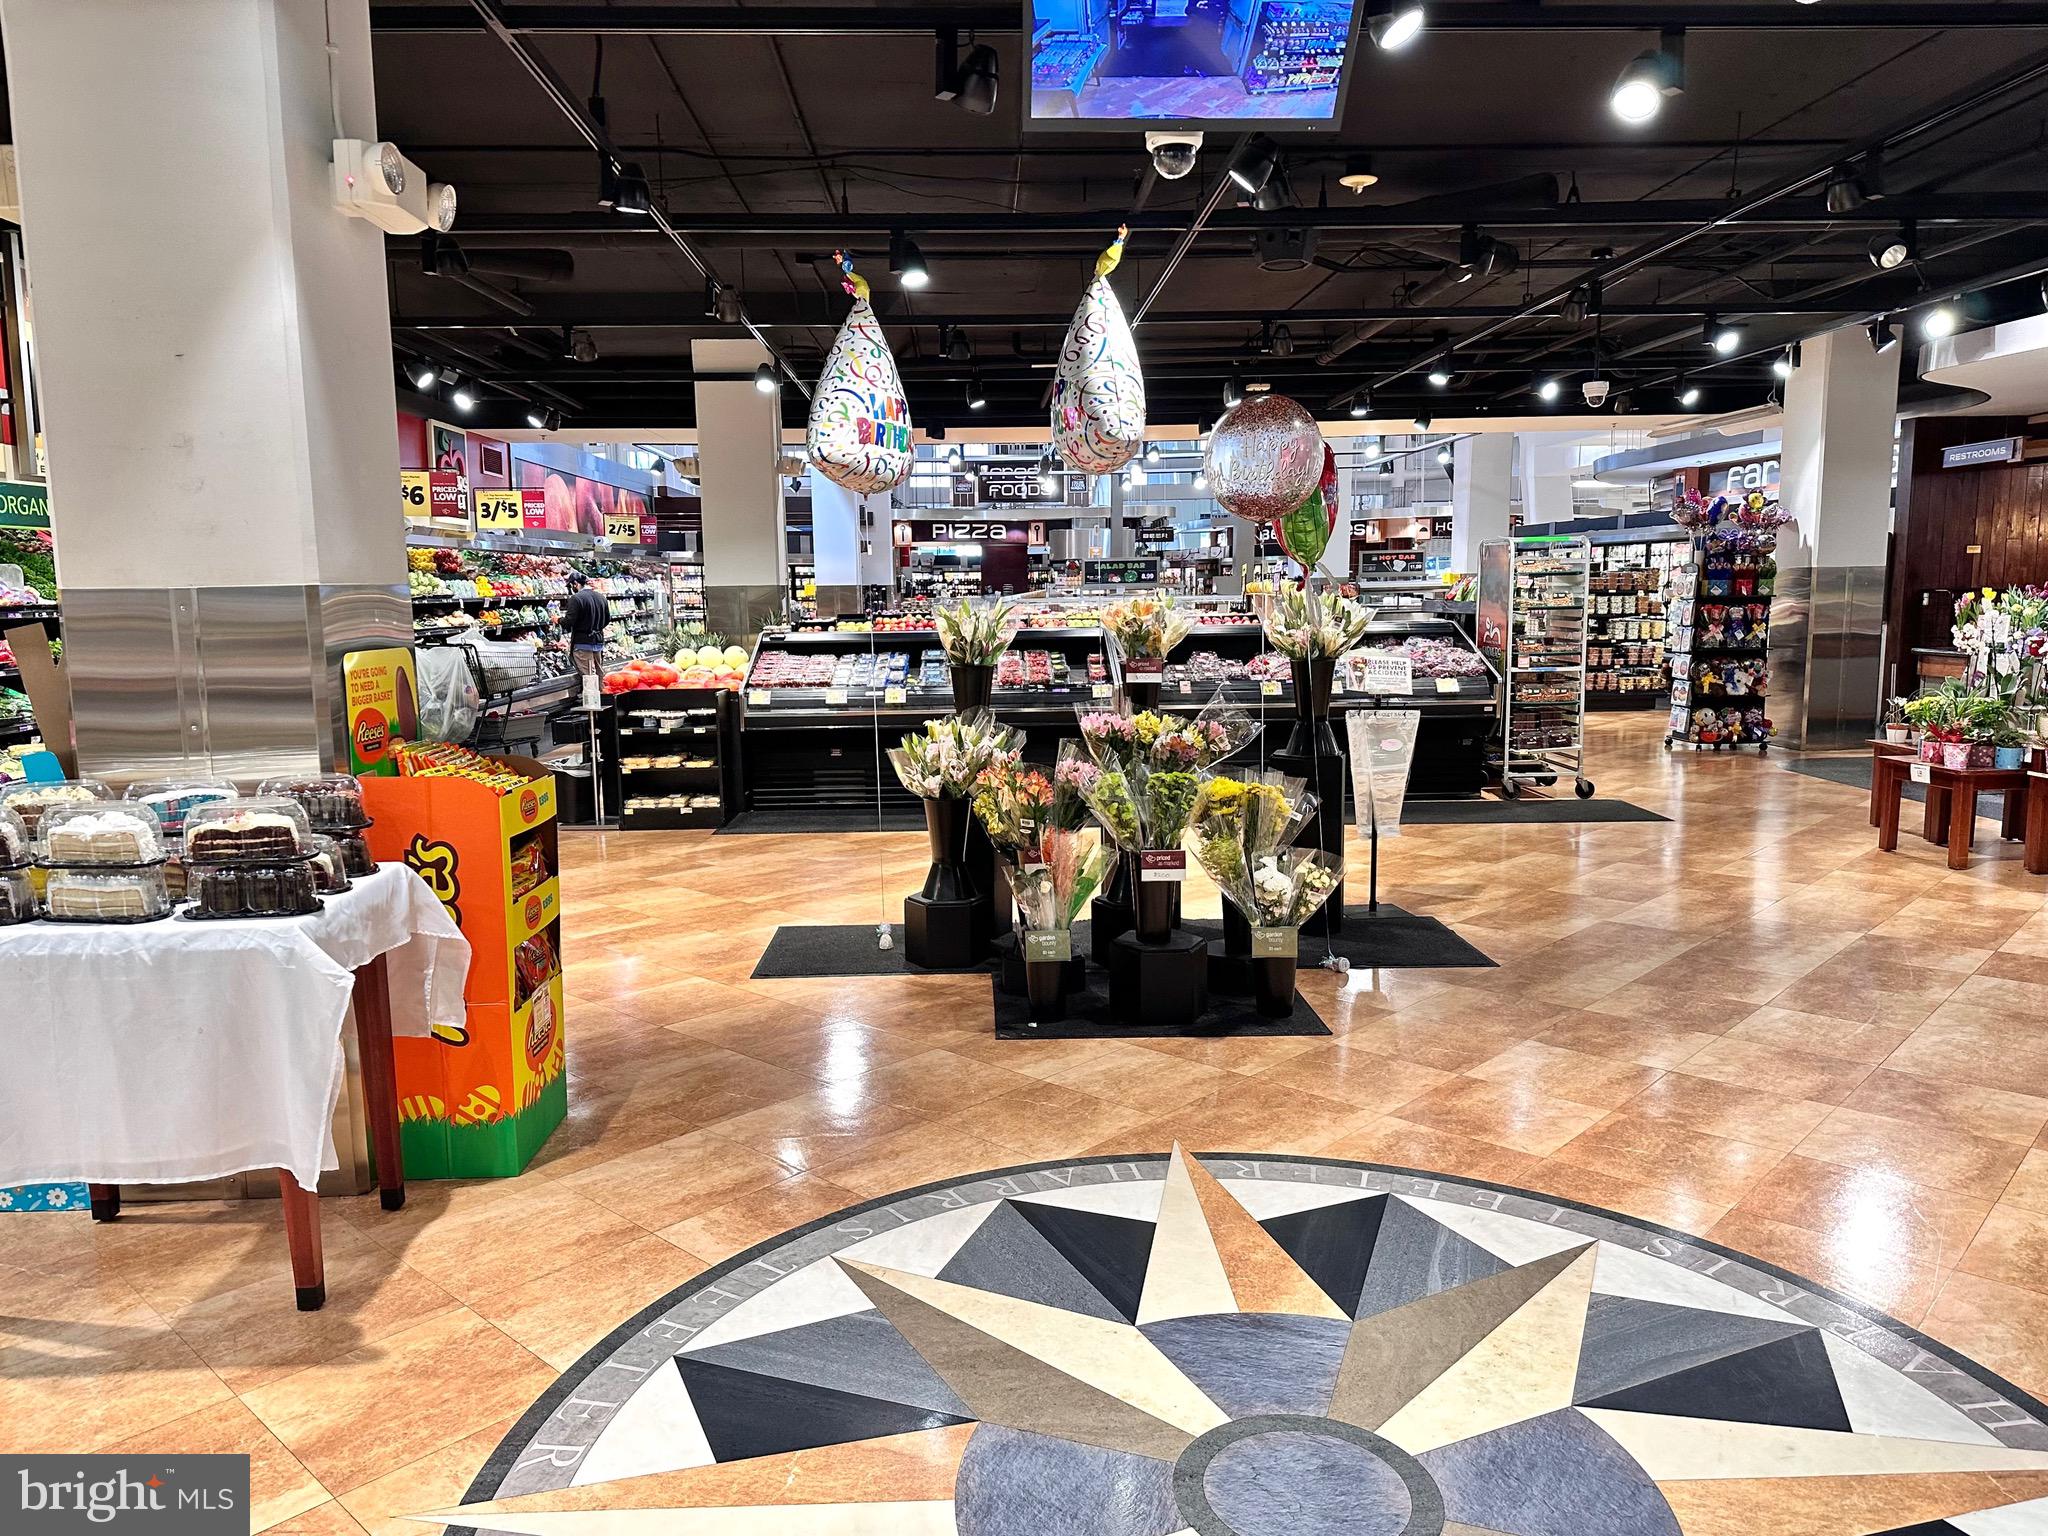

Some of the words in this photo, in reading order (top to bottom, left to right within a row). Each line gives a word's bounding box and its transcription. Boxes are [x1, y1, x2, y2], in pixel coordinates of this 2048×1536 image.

[1949, 446, 2006, 462] RESTROOMS
[401, 484, 425, 505] $6
[434, 493, 457, 501] LOW
[480, 500, 518, 521] 3/$5
[525, 508, 544, 516] LOW
[608, 523, 636, 536] 2/$5
[1094, 562, 1126, 570] SALAD
[1127, 562, 1146, 570] BAR
[350, 667, 370, 680] YOU'RE
[370, 665, 388, 678] GOING
[351, 682, 359, 694] TO
[360, 680, 375, 692] NEED
[375, 680, 380, 689] A
[351, 694, 374, 707] BIGGER
[374, 689, 393, 703] BASKET
[357, 720, 385, 743] Reese's
[836, 1163, 1144, 1241] HARRIS
[1236, 1162, 1569, 1225] TEETER
[1641, 1237, 2046, 1432] HARRIS
[513, 1259, 798, 1473] TEETER
